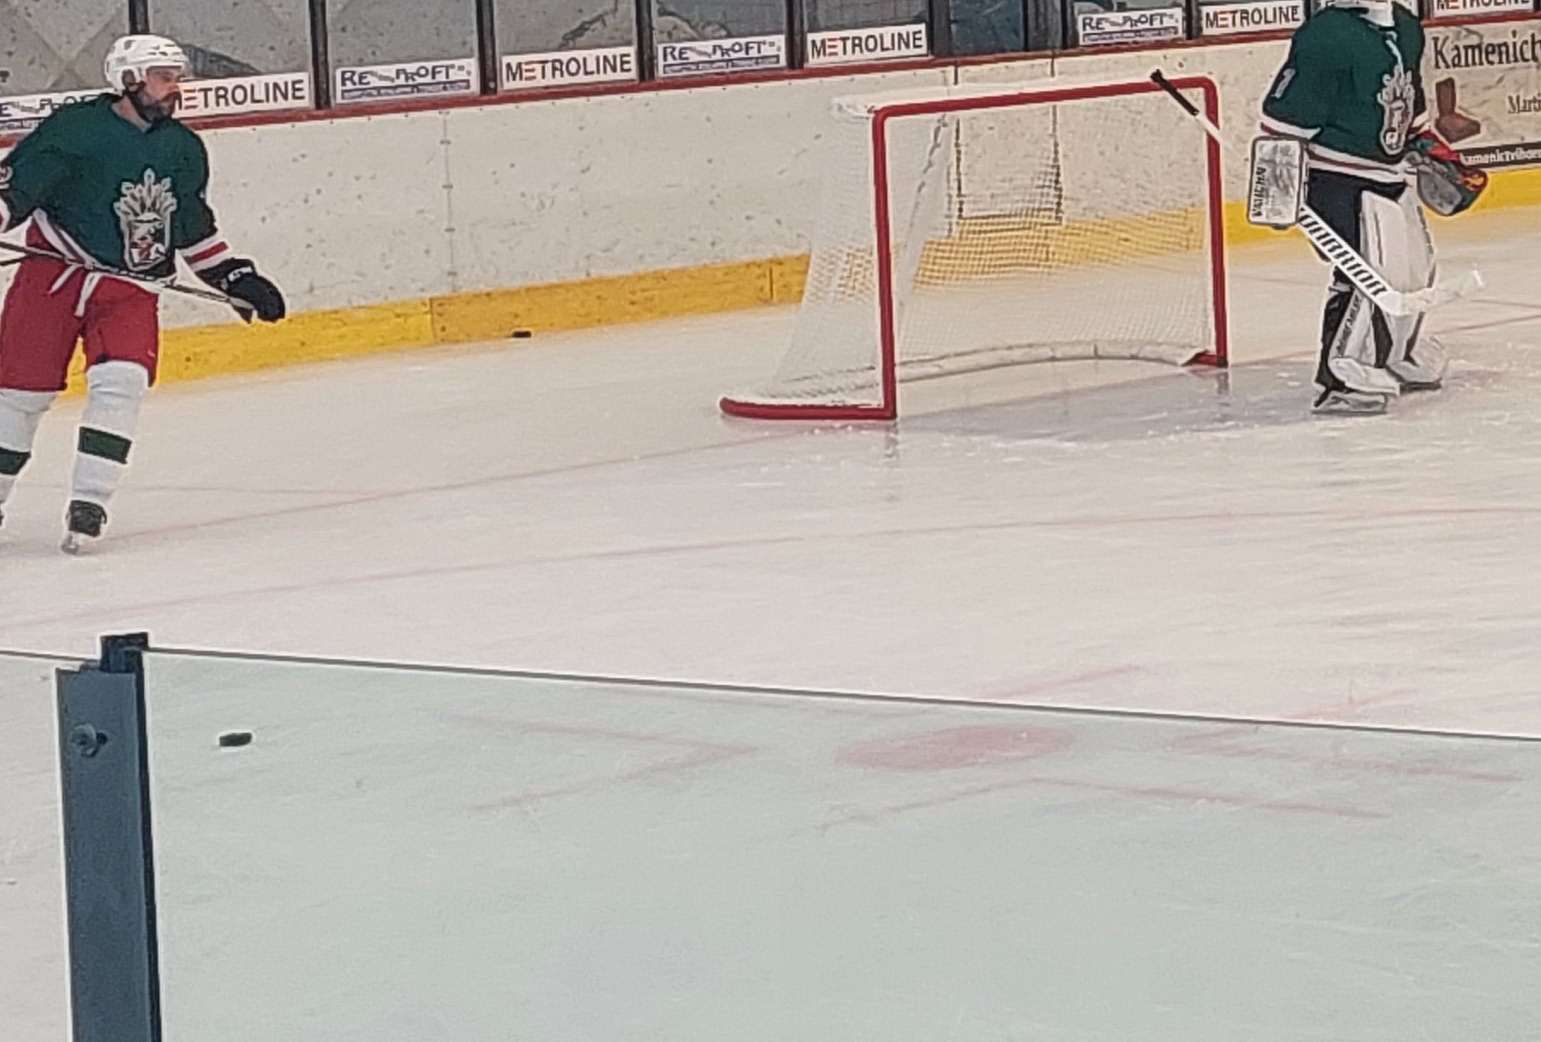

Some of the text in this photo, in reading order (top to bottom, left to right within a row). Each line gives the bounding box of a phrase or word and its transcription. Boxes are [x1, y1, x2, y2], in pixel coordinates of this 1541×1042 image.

[1205, 5, 1300, 29] METROLINE
[811, 30, 923, 58] METROLINE
[506, 52, 632, 82] METROLINE
